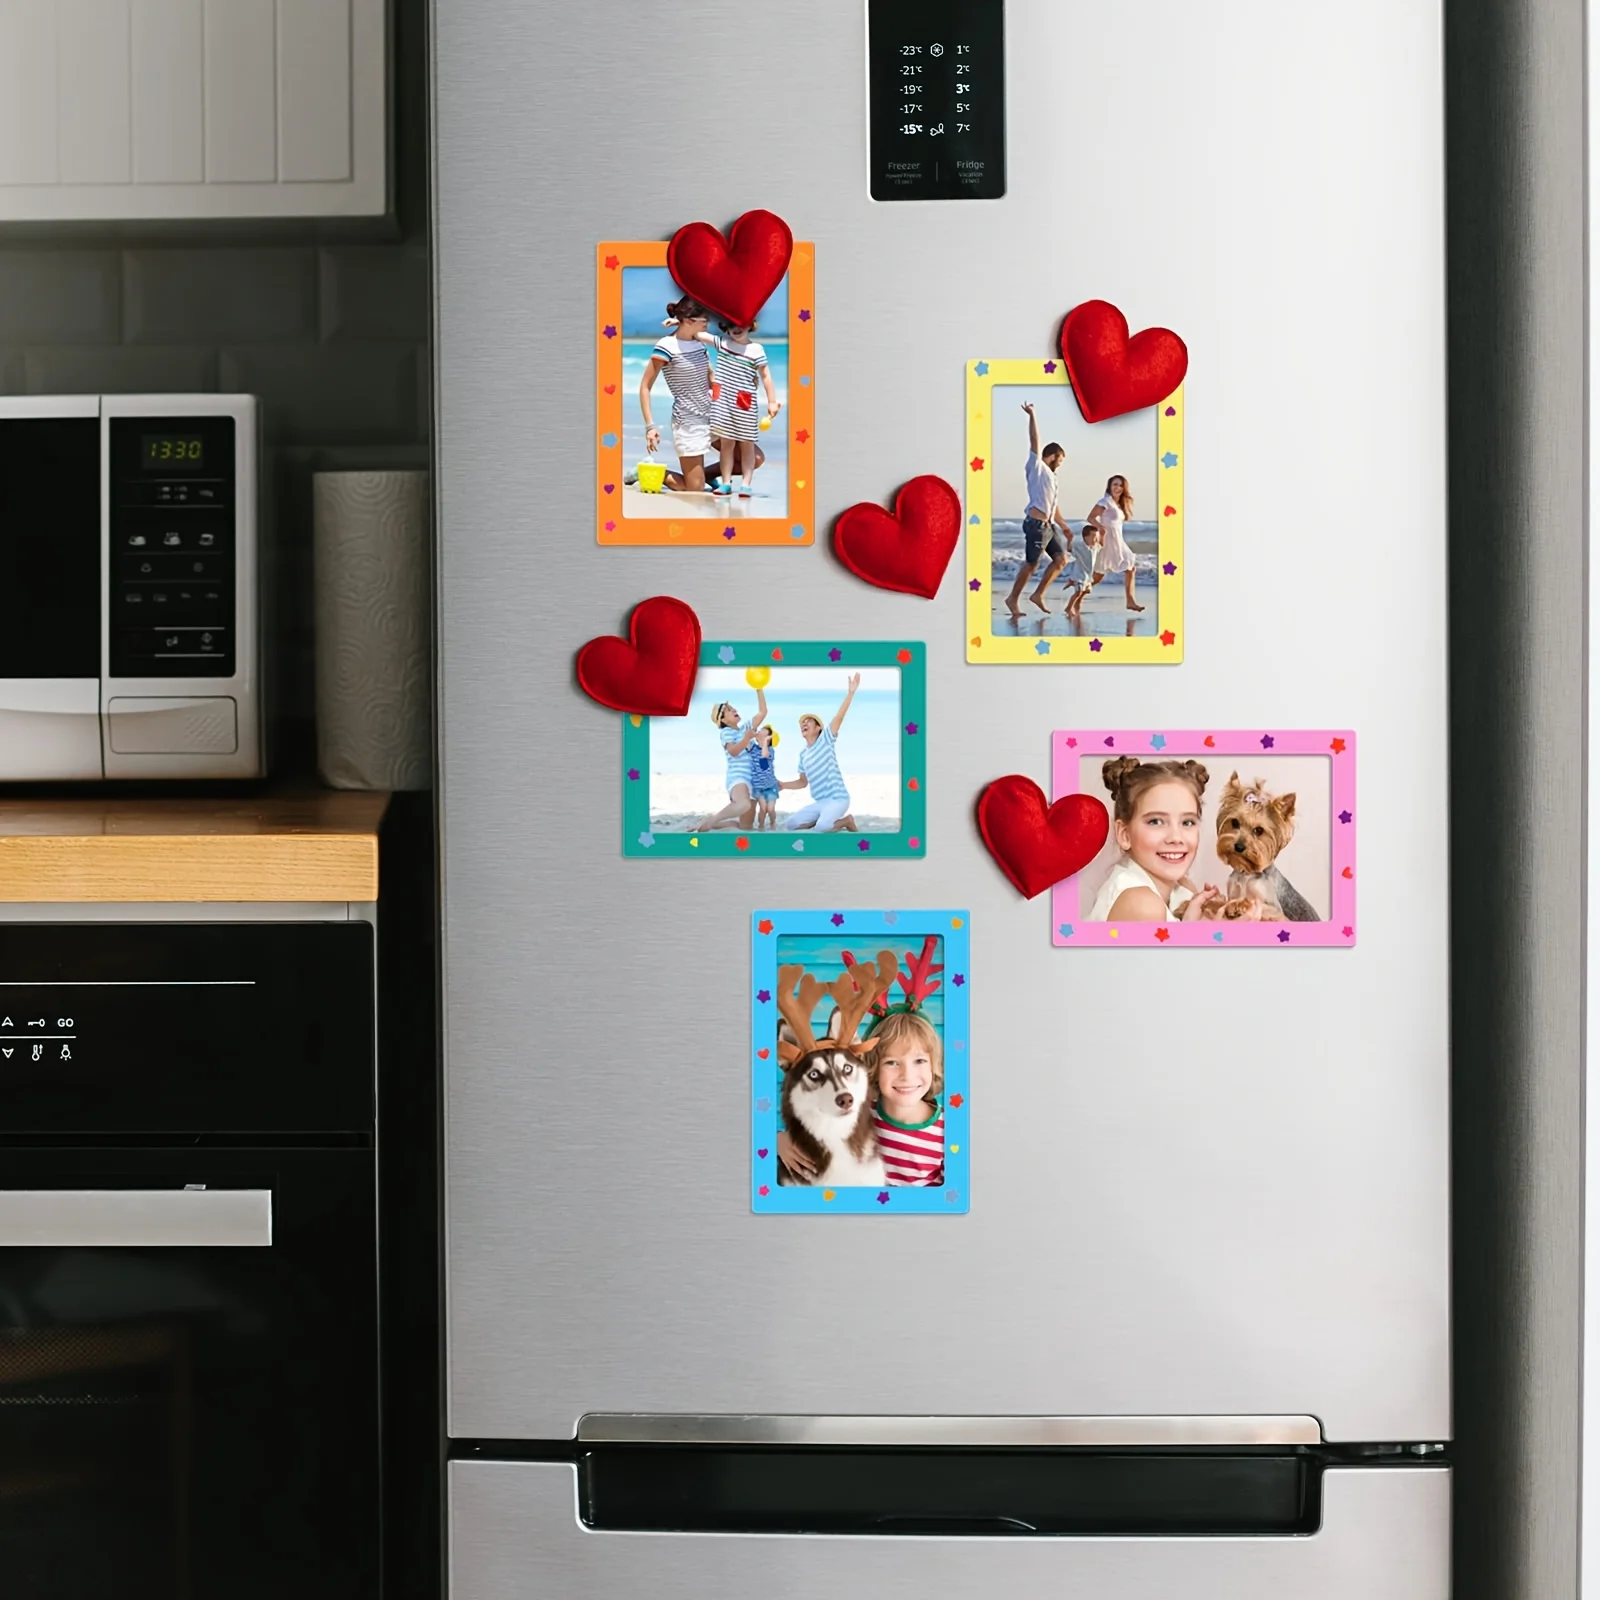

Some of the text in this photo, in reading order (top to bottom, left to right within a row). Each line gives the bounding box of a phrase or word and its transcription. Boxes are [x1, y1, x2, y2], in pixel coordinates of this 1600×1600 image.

[887, 161, 921, 170] Freezer
[956, 160, 985, 171] Fridge
[57, 1017, 74, 1028] GO
